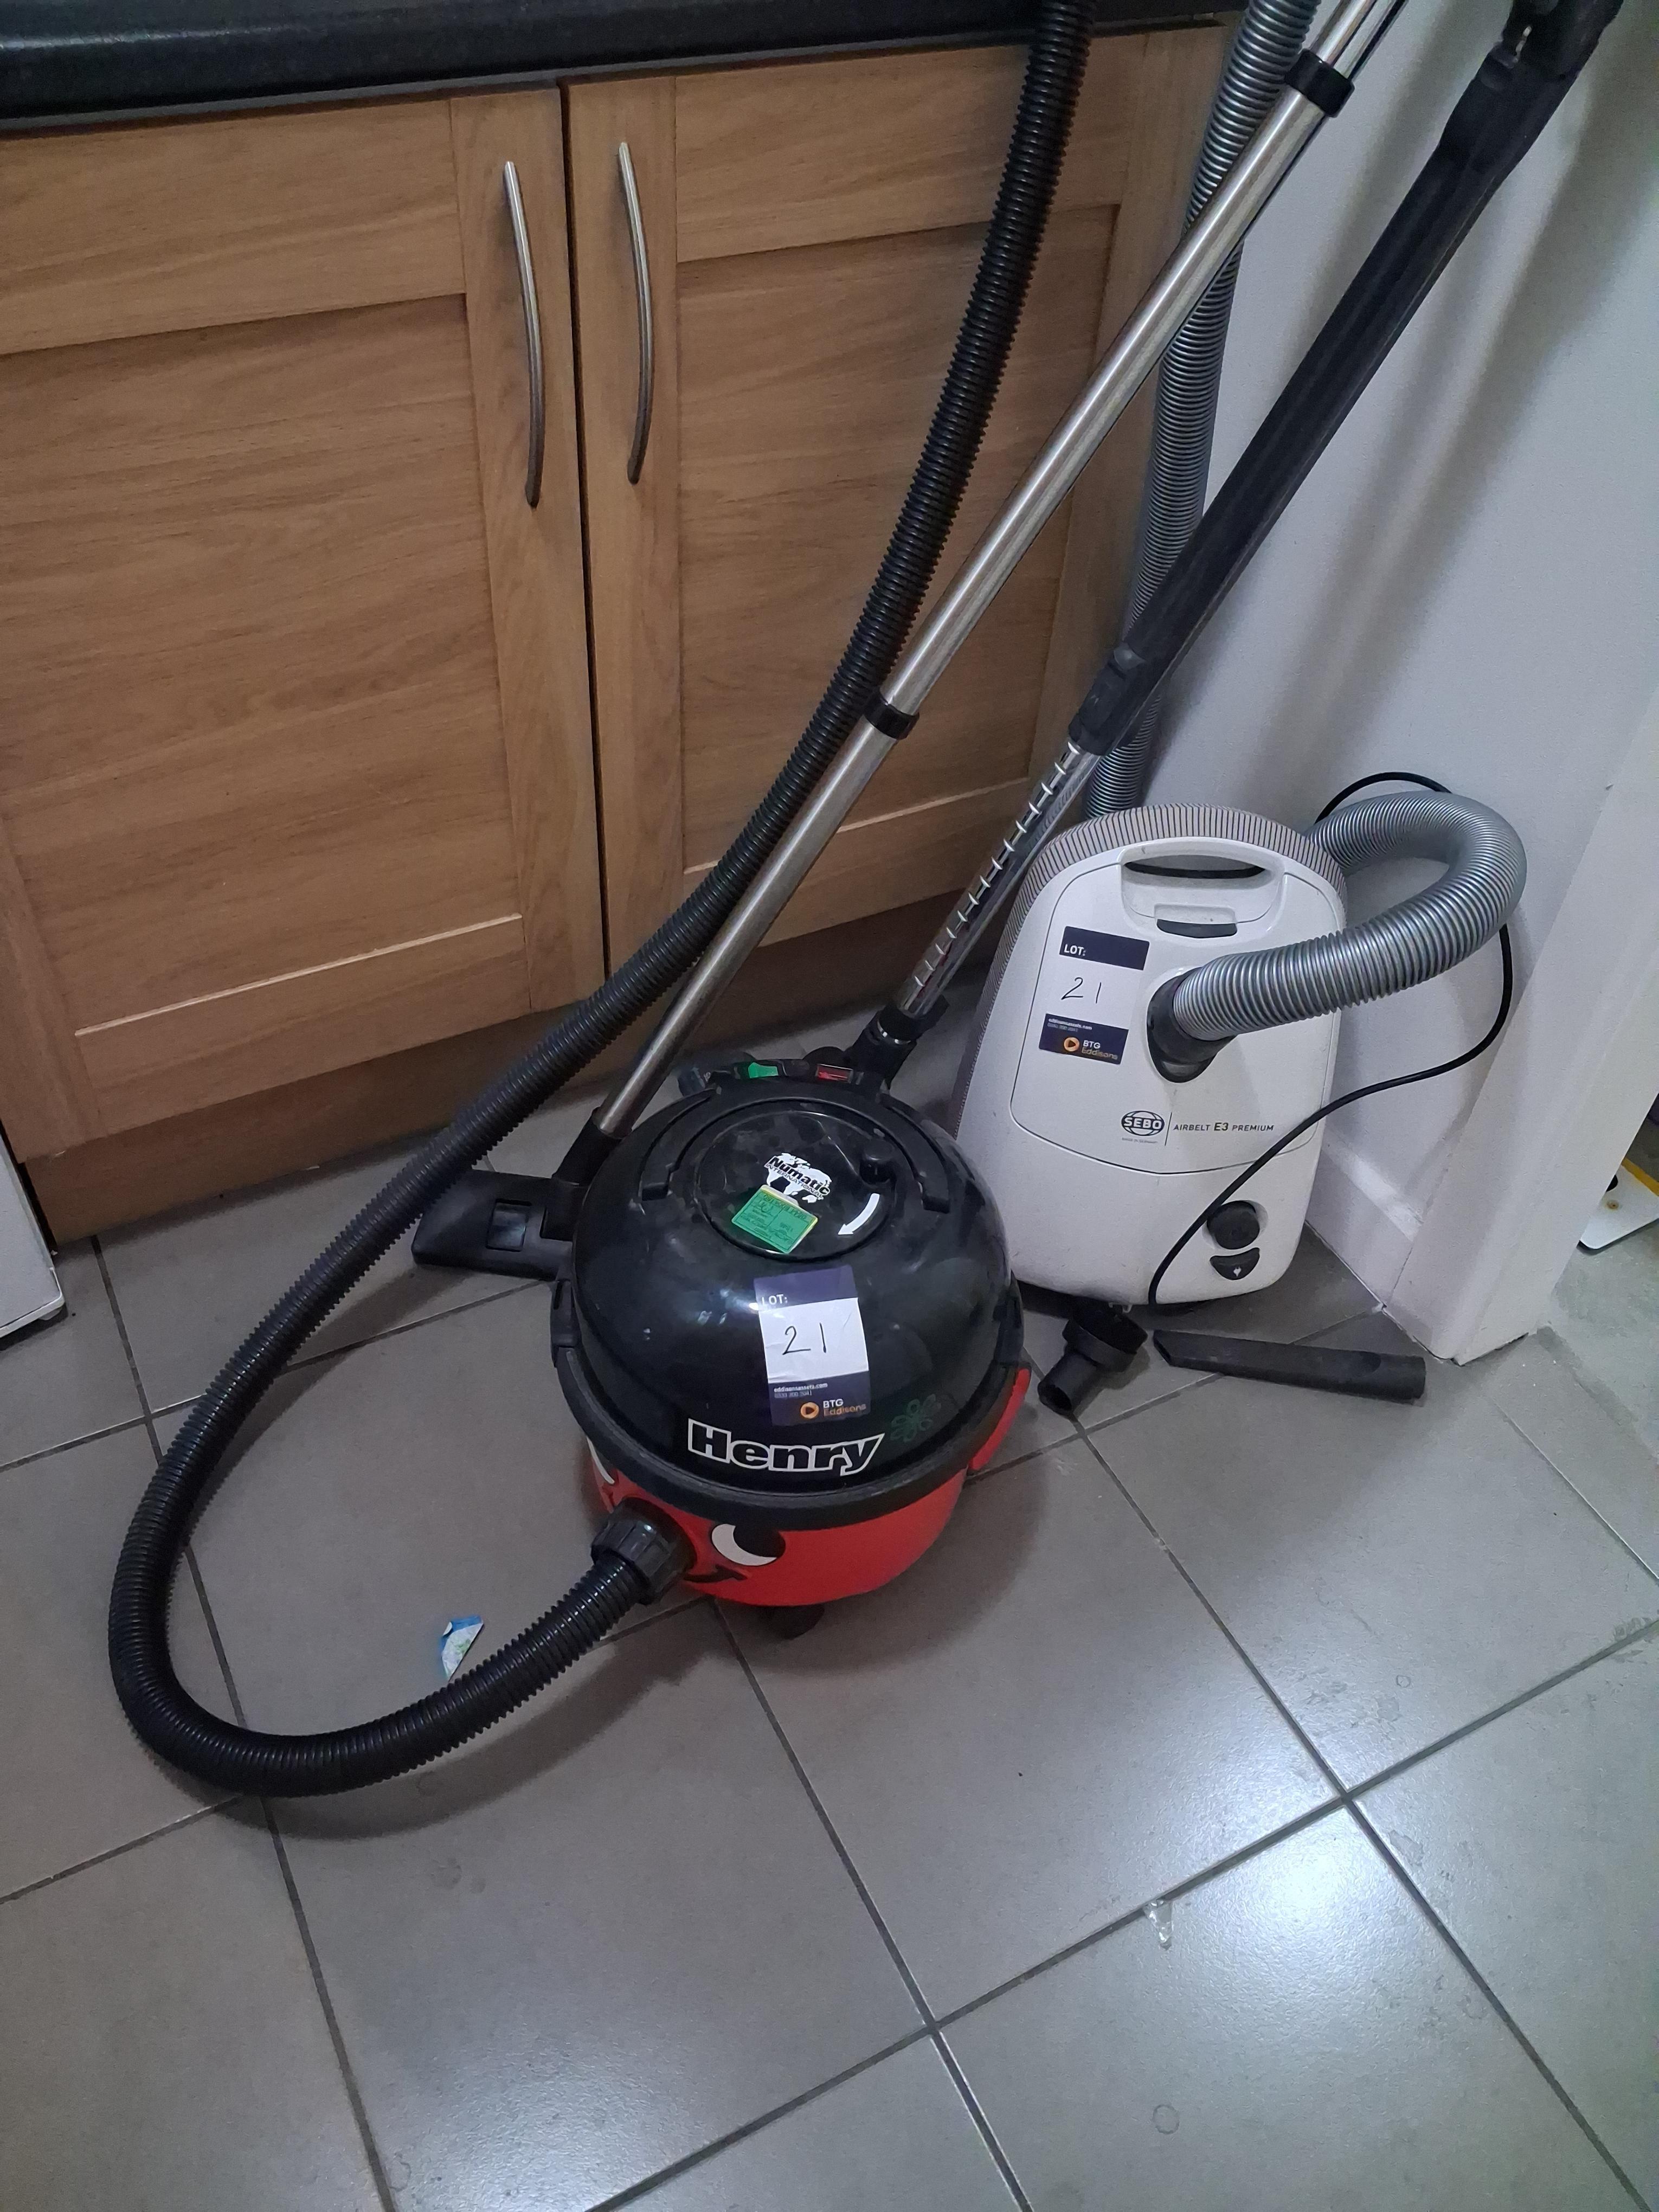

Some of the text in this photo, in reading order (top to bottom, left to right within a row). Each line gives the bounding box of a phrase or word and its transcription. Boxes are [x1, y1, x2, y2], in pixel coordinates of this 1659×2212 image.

[1064, 944, 1086, 956] LOT:
[1083, 1040, 1101, 1049] BTG
[1082, 1047, 1118, 1060] Eddisons
[1123, 1116, 1163, 1130] SEBO
[1173, 1122, 1274, 1132] AIRBELT E3 PREMIUM
[766, 1163, 824, 1199] INTERNATIONAL
[768, 1157, 830, 1195] Numatic
[761, 1294, 788, 1306] LOT:
[782, 1322, 827, 1355] 21
[823, 1398, 844, 1409] BTG
[688, 1418, 885, 1476] Henry
